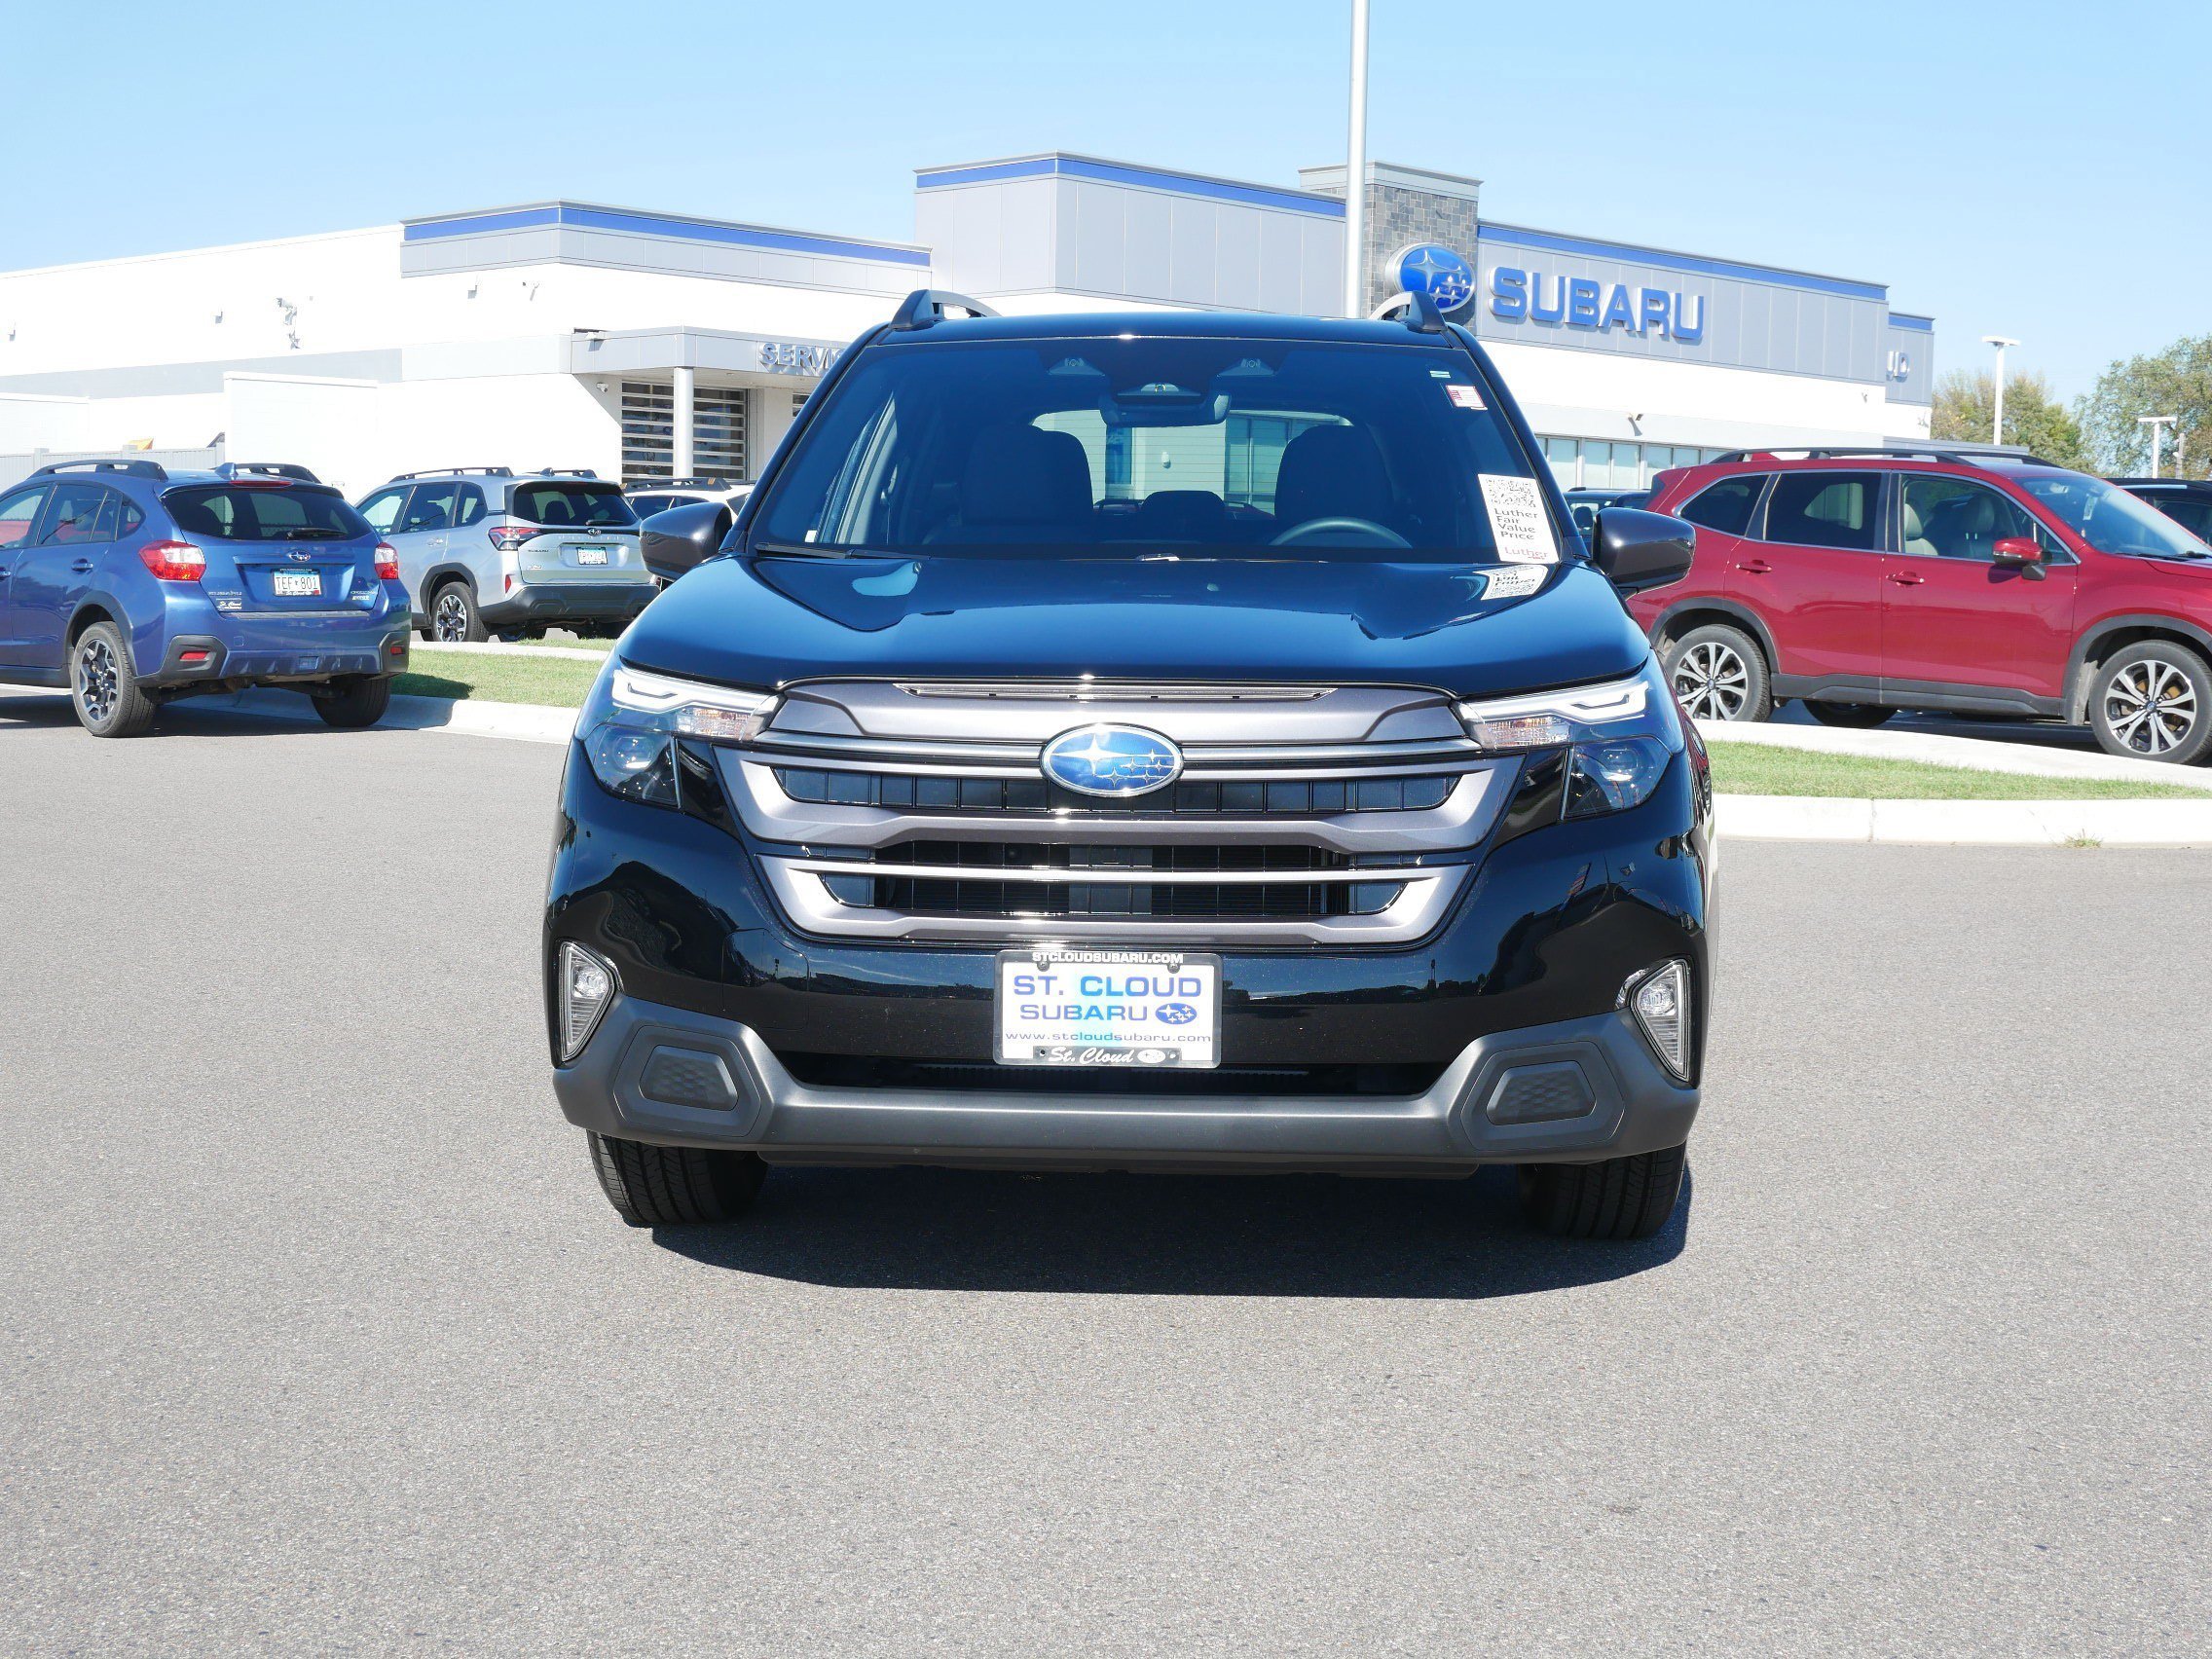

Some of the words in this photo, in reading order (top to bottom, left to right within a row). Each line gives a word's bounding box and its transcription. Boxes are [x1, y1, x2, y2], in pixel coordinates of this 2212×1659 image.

[1490, 266, 1705, 340] SUBARU
[1493, 507, 1538, 519] Luther
[1495, 515, 1520, 524] Fair
[1497, 523, 1536, 534] Value
[1500, 531, 1535, 540] Price
[1032, 951, 1184, 964] STCLOUDSUBARU.COM
[1014, 975, 1064, 996] ST.
[1080, 976, 1202, 997] CLOUD
[1019, 1004, 1148, 1021] SUBARU
[1006, 1031, 1211, 1043] www.stcloudsubaru.com
[1048, 1046, 1076, 1063] St.
[1079, 1047, 1134, 1064] Cloud
